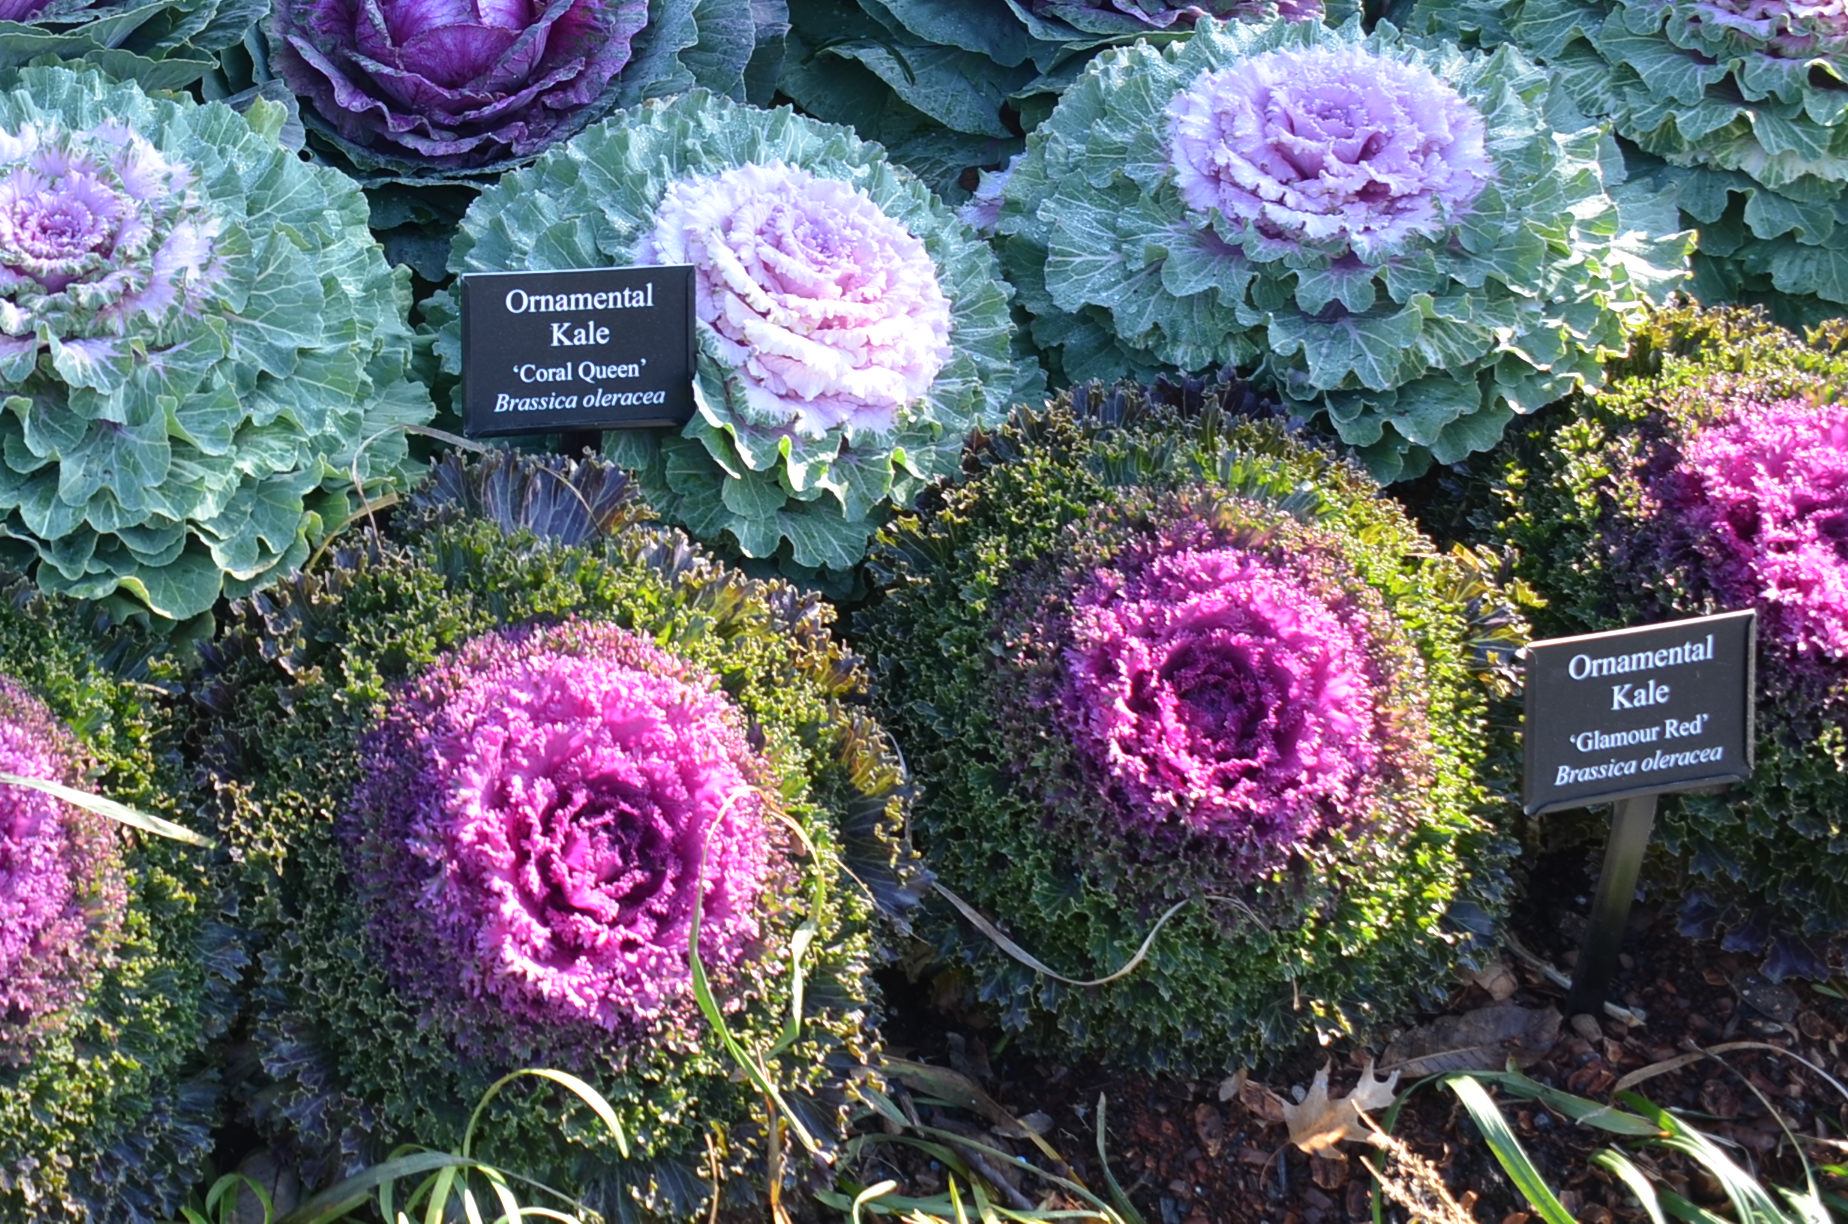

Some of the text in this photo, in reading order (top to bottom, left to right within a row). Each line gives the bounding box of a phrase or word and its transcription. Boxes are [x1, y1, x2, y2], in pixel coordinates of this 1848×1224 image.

[505, 283, 653, 313] Ornamental
[550, 321, 610, 346] Kale
[494, 388, 665, 412] Brassica oleracea
[1568, 634, 1714, 680] Ornamental
[1611, 679, 1670, 710] Kale
[1554, 746, 1724, 787] Brassica oleracea
